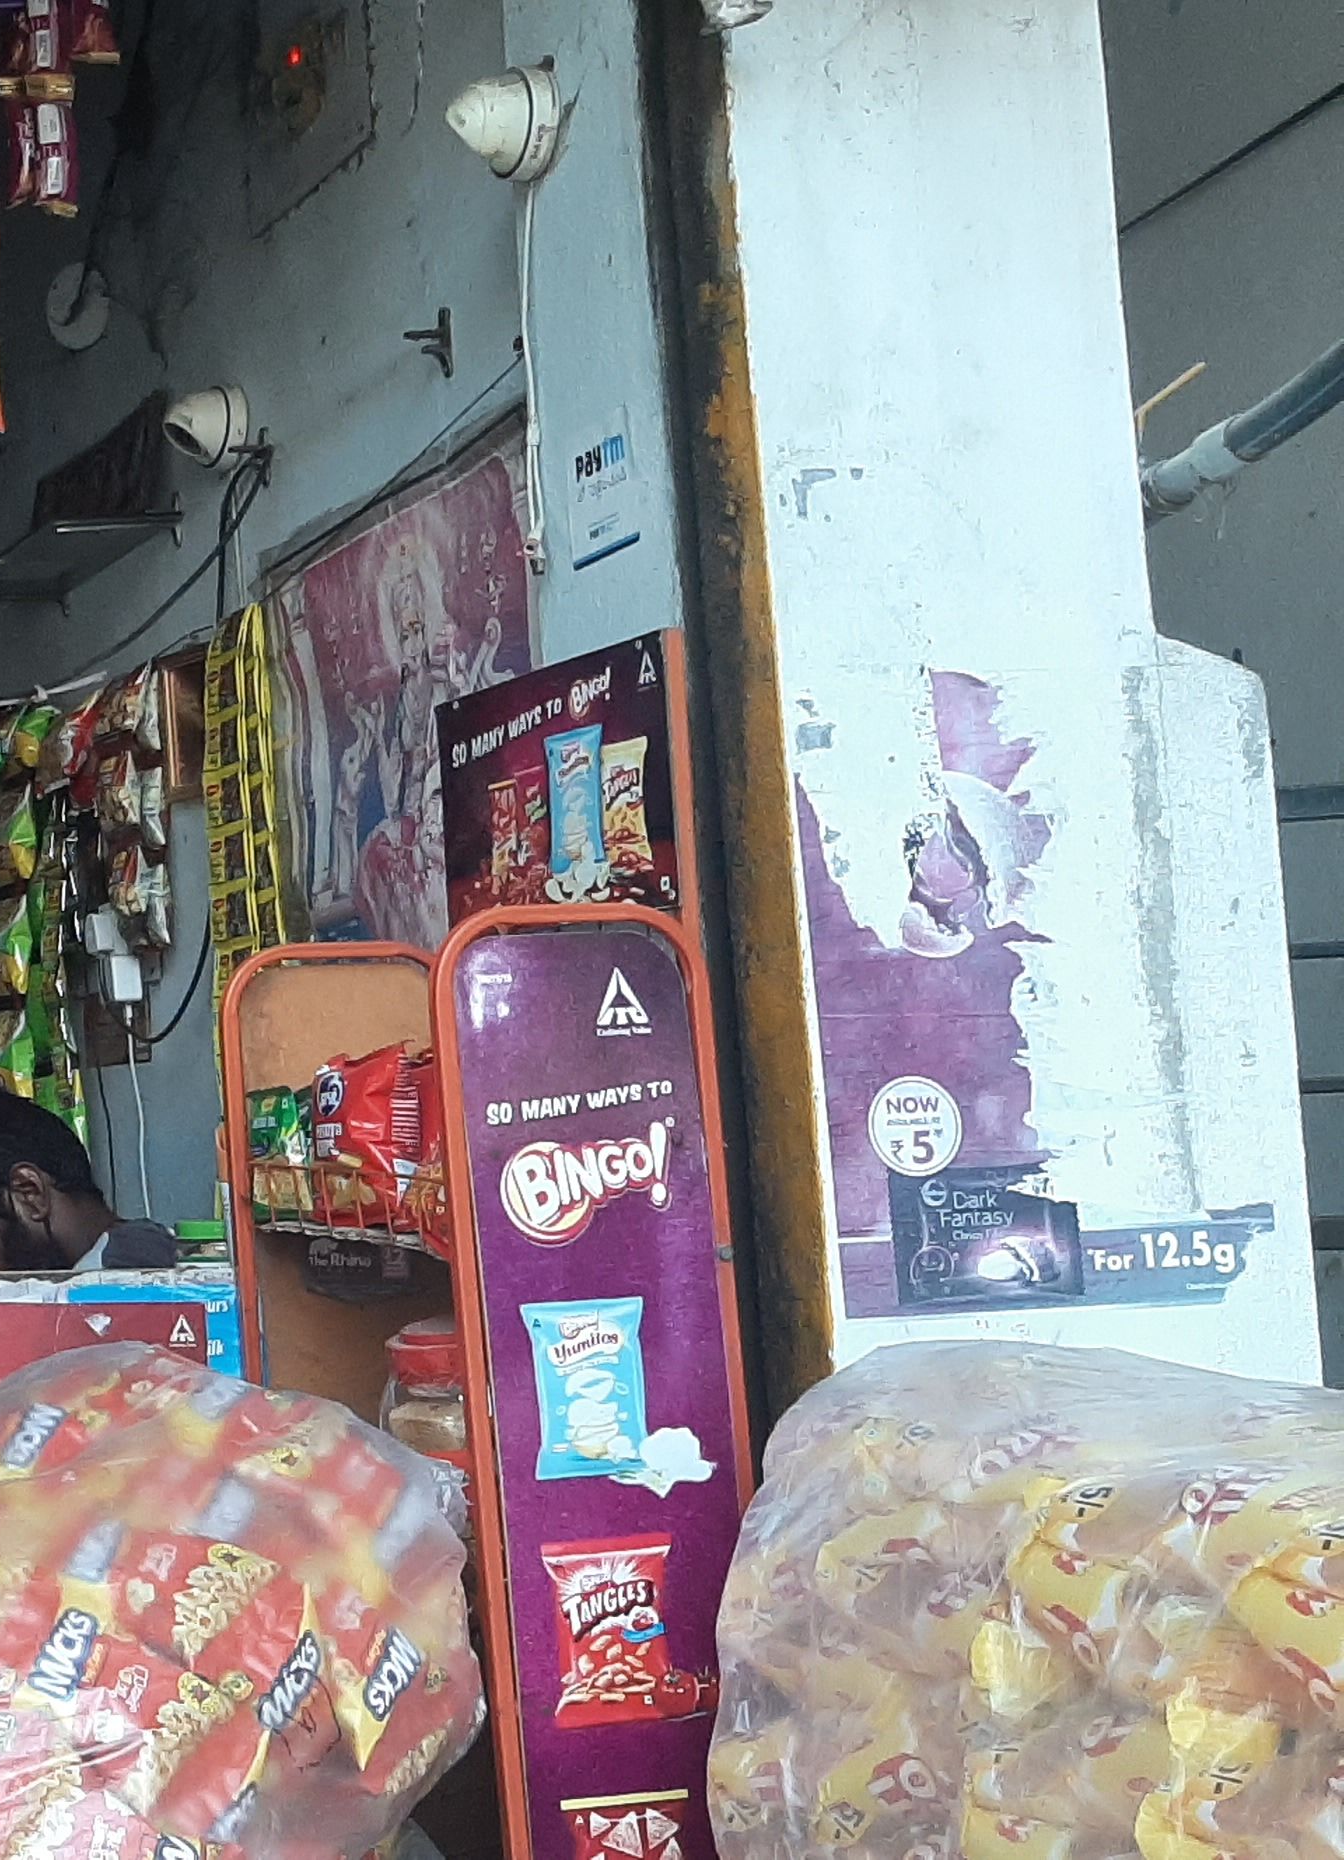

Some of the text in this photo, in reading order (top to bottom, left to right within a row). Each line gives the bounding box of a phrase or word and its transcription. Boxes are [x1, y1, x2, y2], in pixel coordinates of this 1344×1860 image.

[452, 742, 467, 768] SO
[471, 724, 505, 761] MANY
[508, 705, 542, 740] WAYS
[546, 697, 562, 719] TO
[486, 1080, 673, 1125] SO MANY WAYS TO
[886, 1097, 939, 1114] NOW
[511, 1121, 668, 1227] BINGO!
[953, 1190, 998, 1210] Dark
[936, 1209, 1014, 1228] Fantasy
[330, 1253, 372, 1268] Rhino
[1139, 1231, 1237, 1275] 12.5g
[206, 1301, 229, 1315] urs
[562, 1581, 647, 1637] TANGLES
